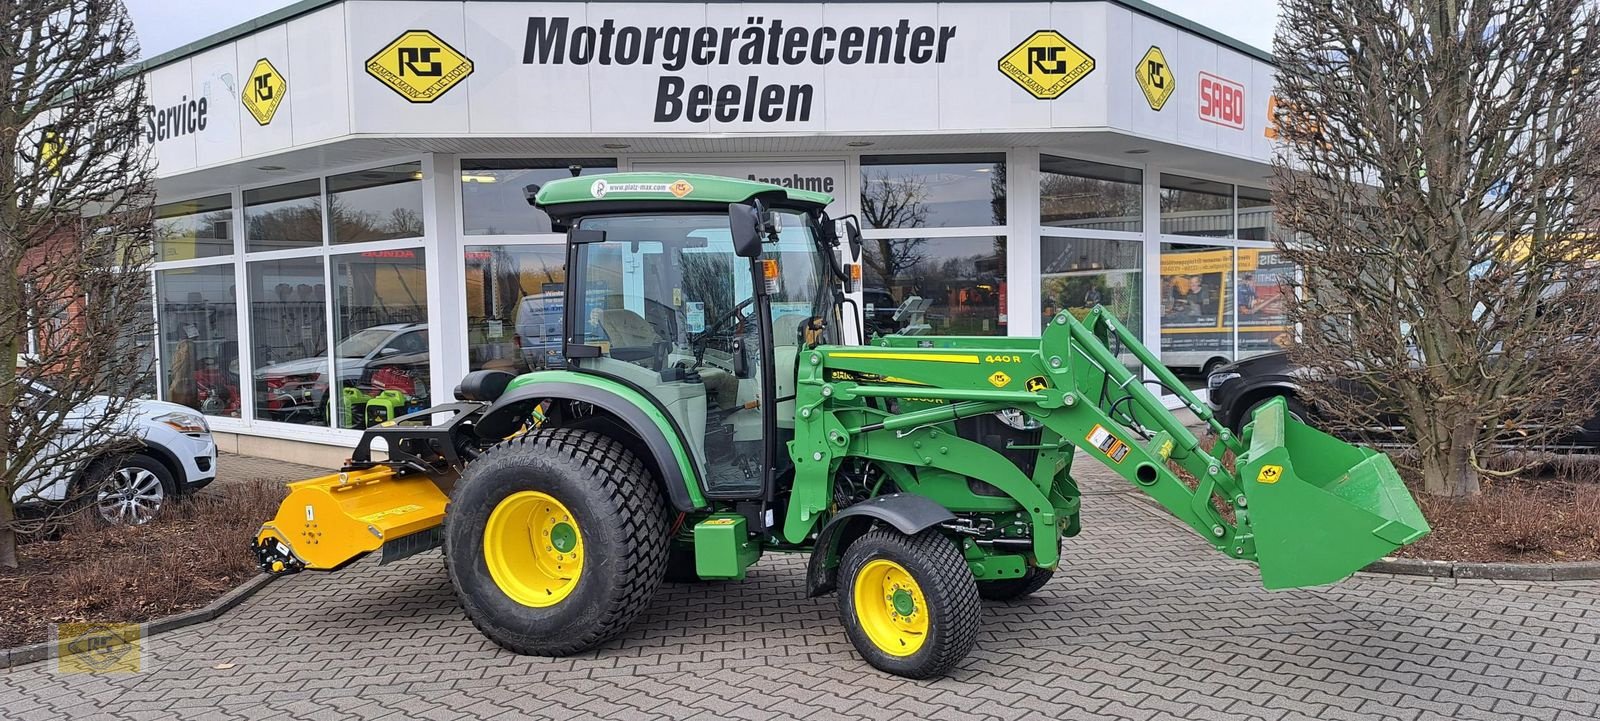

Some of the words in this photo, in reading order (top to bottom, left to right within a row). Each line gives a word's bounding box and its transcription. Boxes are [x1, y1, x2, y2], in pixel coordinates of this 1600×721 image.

[522, 16, 957, 71] Motorgerätecenter
[398, 47, 443, 76] RS
[1027, 46, 1067, 74] RS
[1147, 60, 1165, 89] RS
[254, 72, 273, 103] RS
[368, 61, 420, 98] RAMPELMANN
[653, 75, 814, 124] Beelen
[1201, 78, 1243, 125] SABO
[985, 355, 1011, 364] 440
[1012, 355, 1021, 363] R
